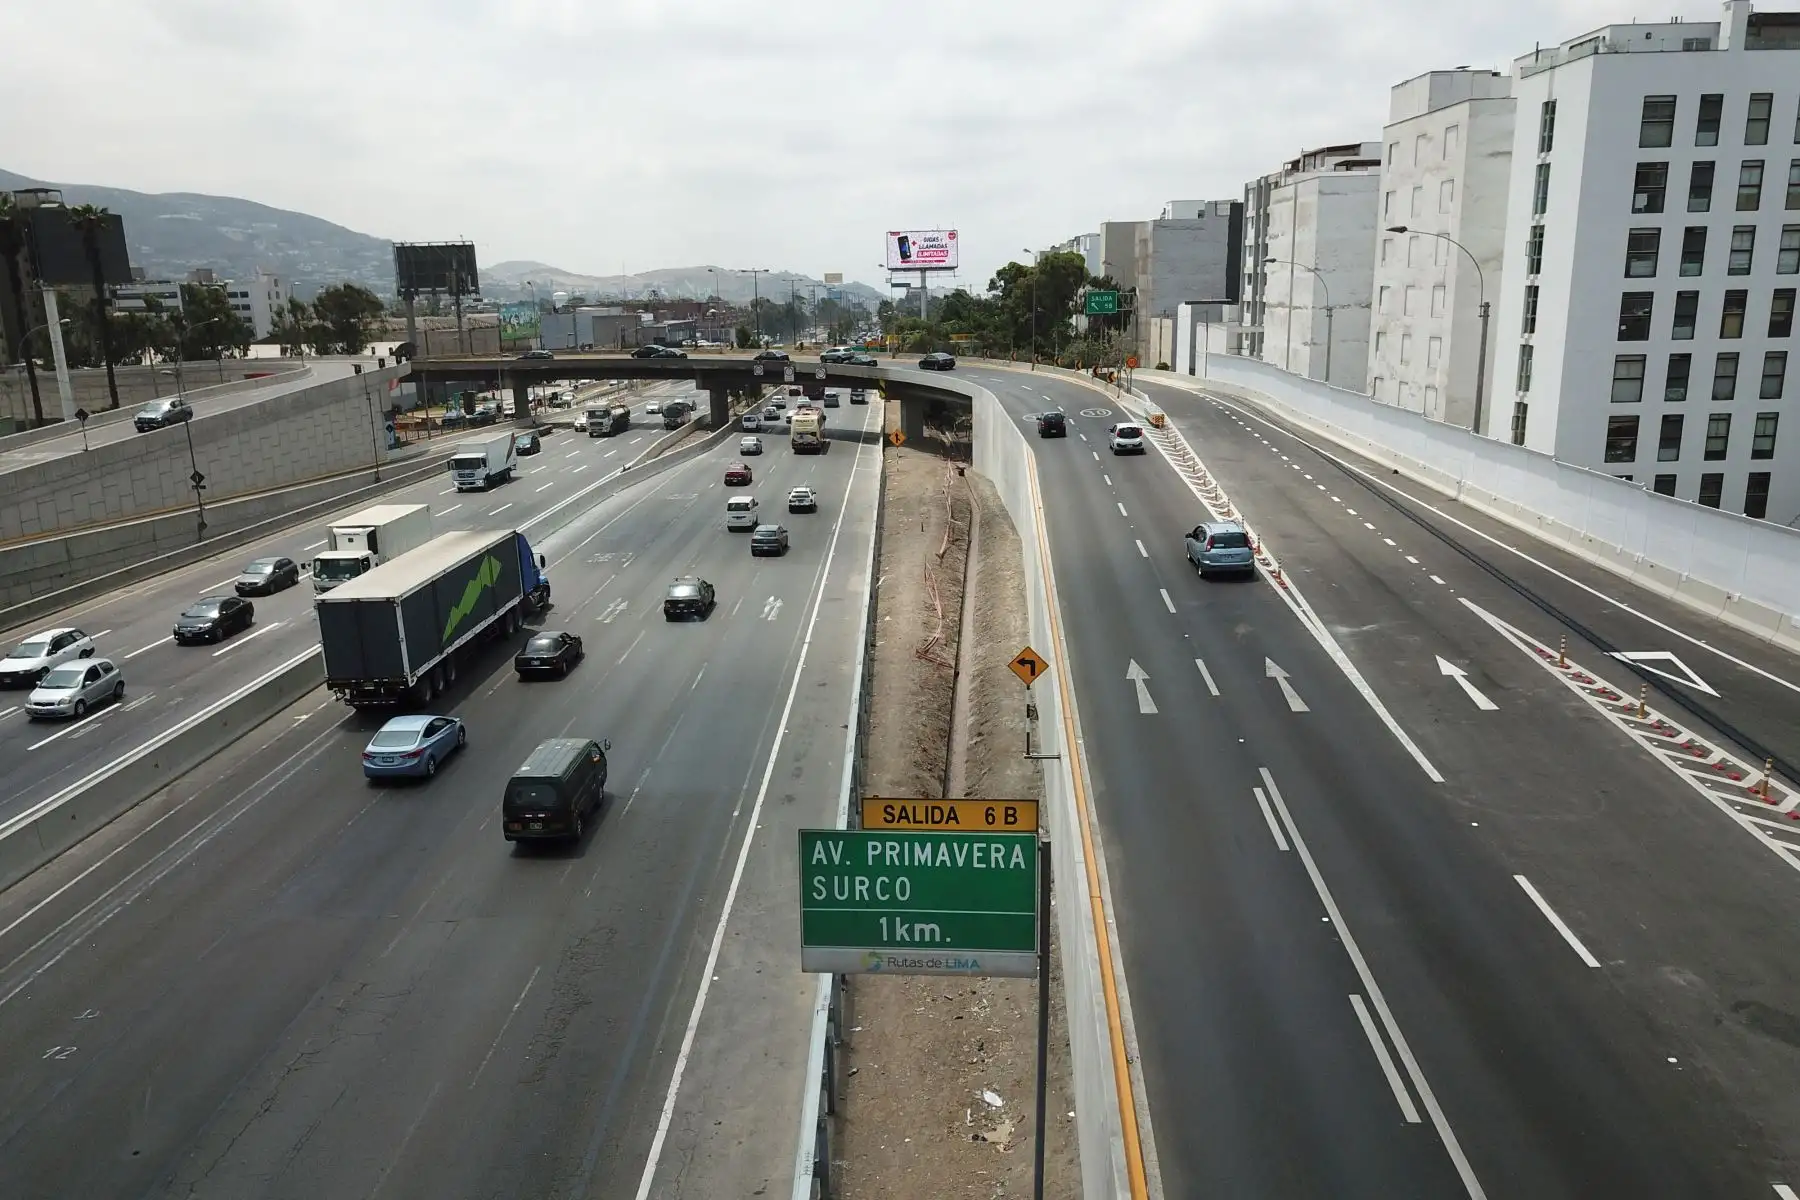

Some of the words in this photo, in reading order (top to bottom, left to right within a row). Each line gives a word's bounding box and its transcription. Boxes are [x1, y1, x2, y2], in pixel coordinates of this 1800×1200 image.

[883, 804, 959, 824] SALIDA
[812, 840, 850, 865] AV.
[867, 841, 1026, 868] PRIMAVERA
[812, 876, 911, 901] SURCO
[887, 957, 923, 968] Rutas
[925, 958, 942, 968] de
[945, 959, 980, 969] LIMA
